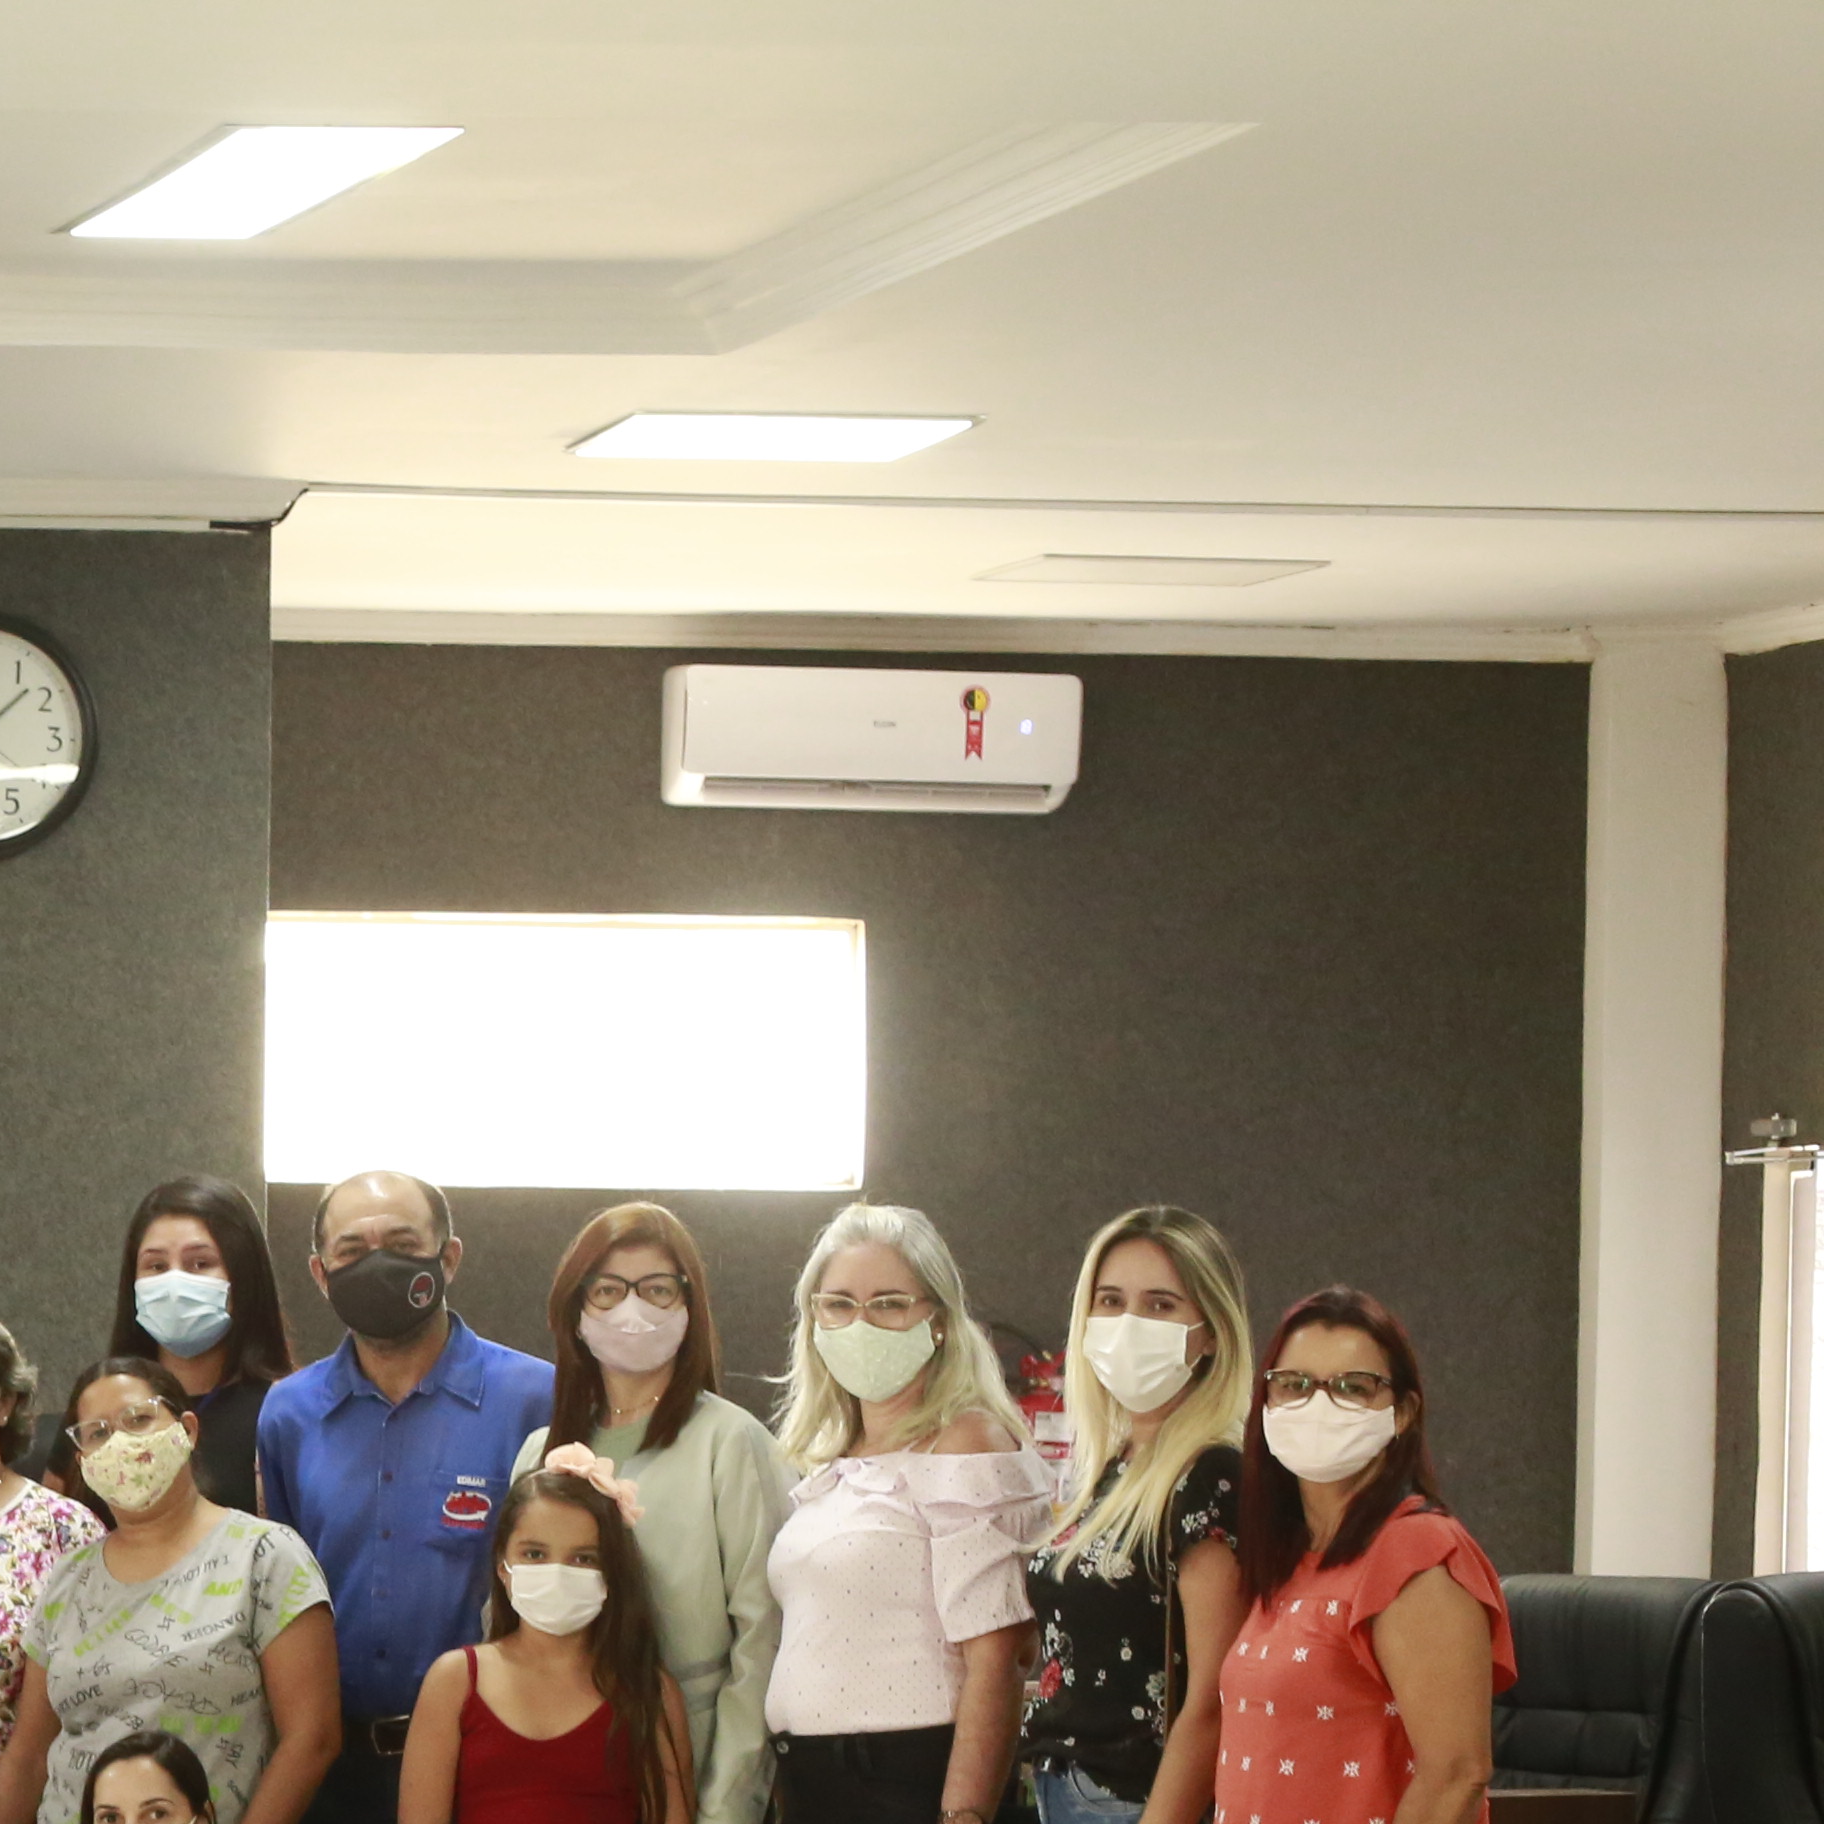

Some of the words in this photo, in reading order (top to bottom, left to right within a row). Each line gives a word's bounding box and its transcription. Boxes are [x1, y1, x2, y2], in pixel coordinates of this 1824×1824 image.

[15, 660, 22, 684] 1
[37, 687, 52, 712] 2
[46, 727, 63, 752] 3
[3, 788, 20, 815] 5
